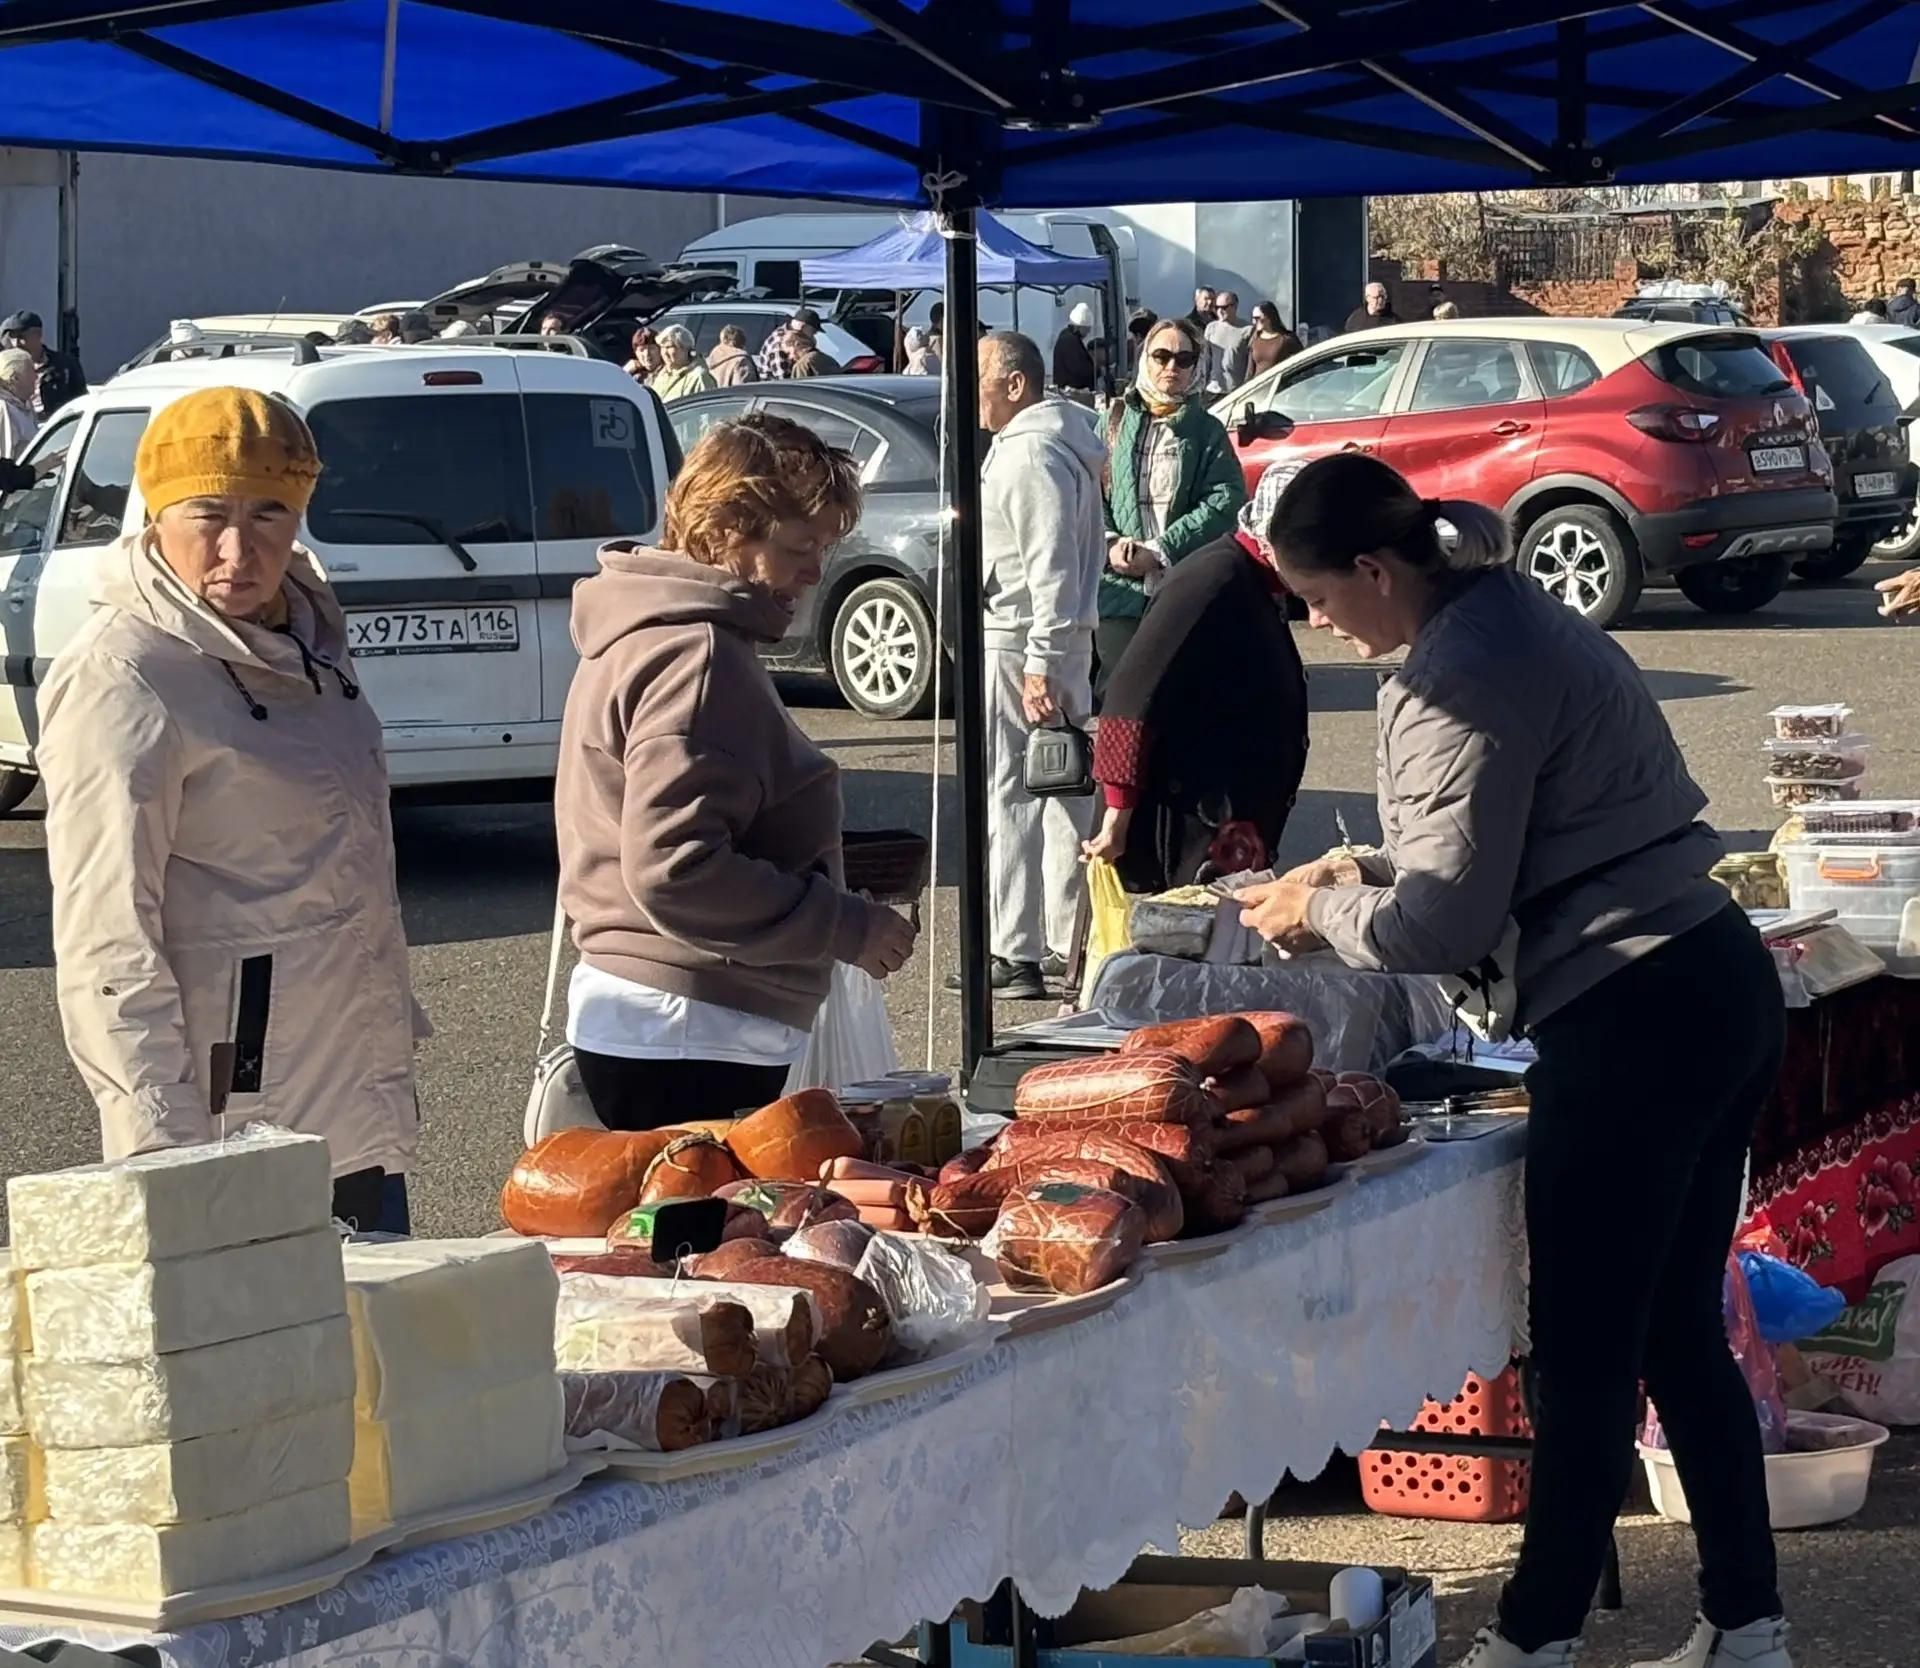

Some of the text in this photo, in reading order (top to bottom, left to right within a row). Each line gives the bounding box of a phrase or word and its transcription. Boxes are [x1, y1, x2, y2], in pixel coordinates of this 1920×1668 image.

[356, 611, 508, 644] Х973ТА 116
[479, 631, 499, 641] RUS
